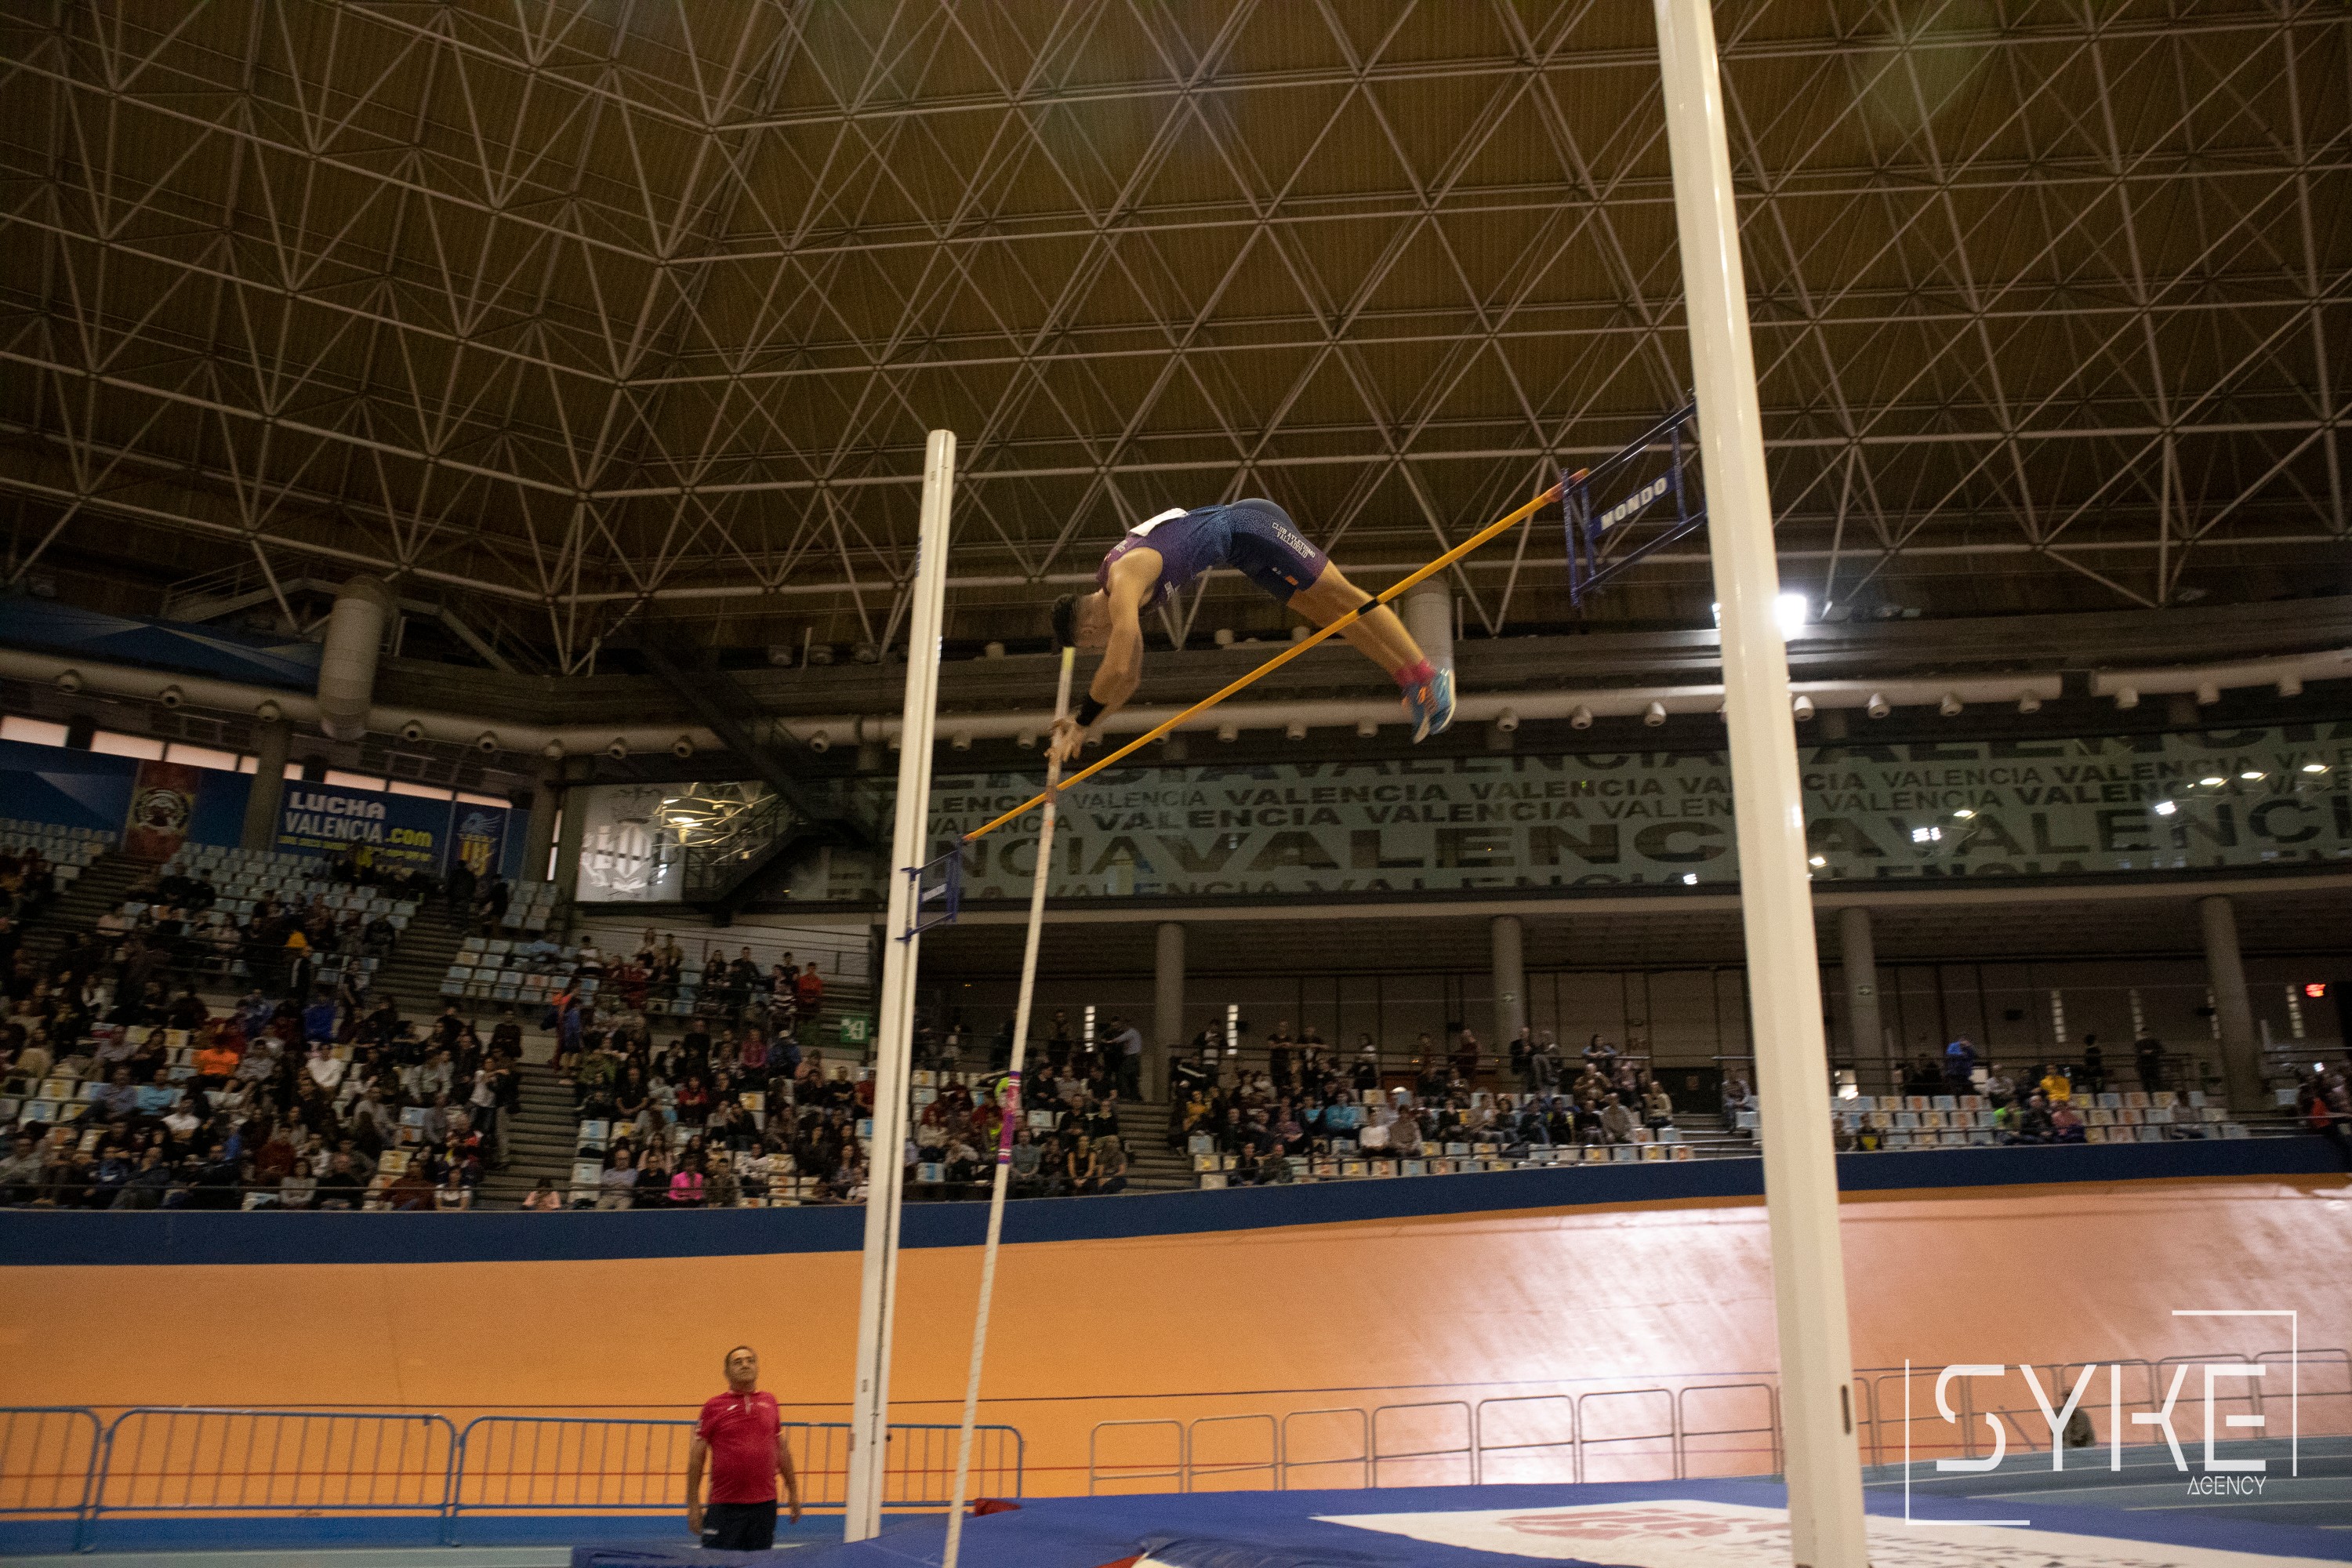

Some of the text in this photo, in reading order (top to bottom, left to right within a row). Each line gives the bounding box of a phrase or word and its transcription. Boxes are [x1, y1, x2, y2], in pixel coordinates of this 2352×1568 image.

[1601, 477, 1668, 531] MONDO
[1272, 521, 1316, 558] CLUB ATLETISMO
[1276, 532, 1308, 558] VALLADOLID
[289, 791, 386, 820] LUCHA
[1071, 789, 1208, 809] VALENCIA
[1224, 784, 1449, 806] VALENCIA
[1470, 779, 1664, 800] VALENCIA
[1882, 767, 2043, 789] VALENCIA
[1091, 807, 1342, 831] VALENCIA
[1364, 800, 1583, 824] VALENCIA
[1820, 789, 2004, 812] VALENCIA
[1156, 816, 1886, 872] VALENCA
